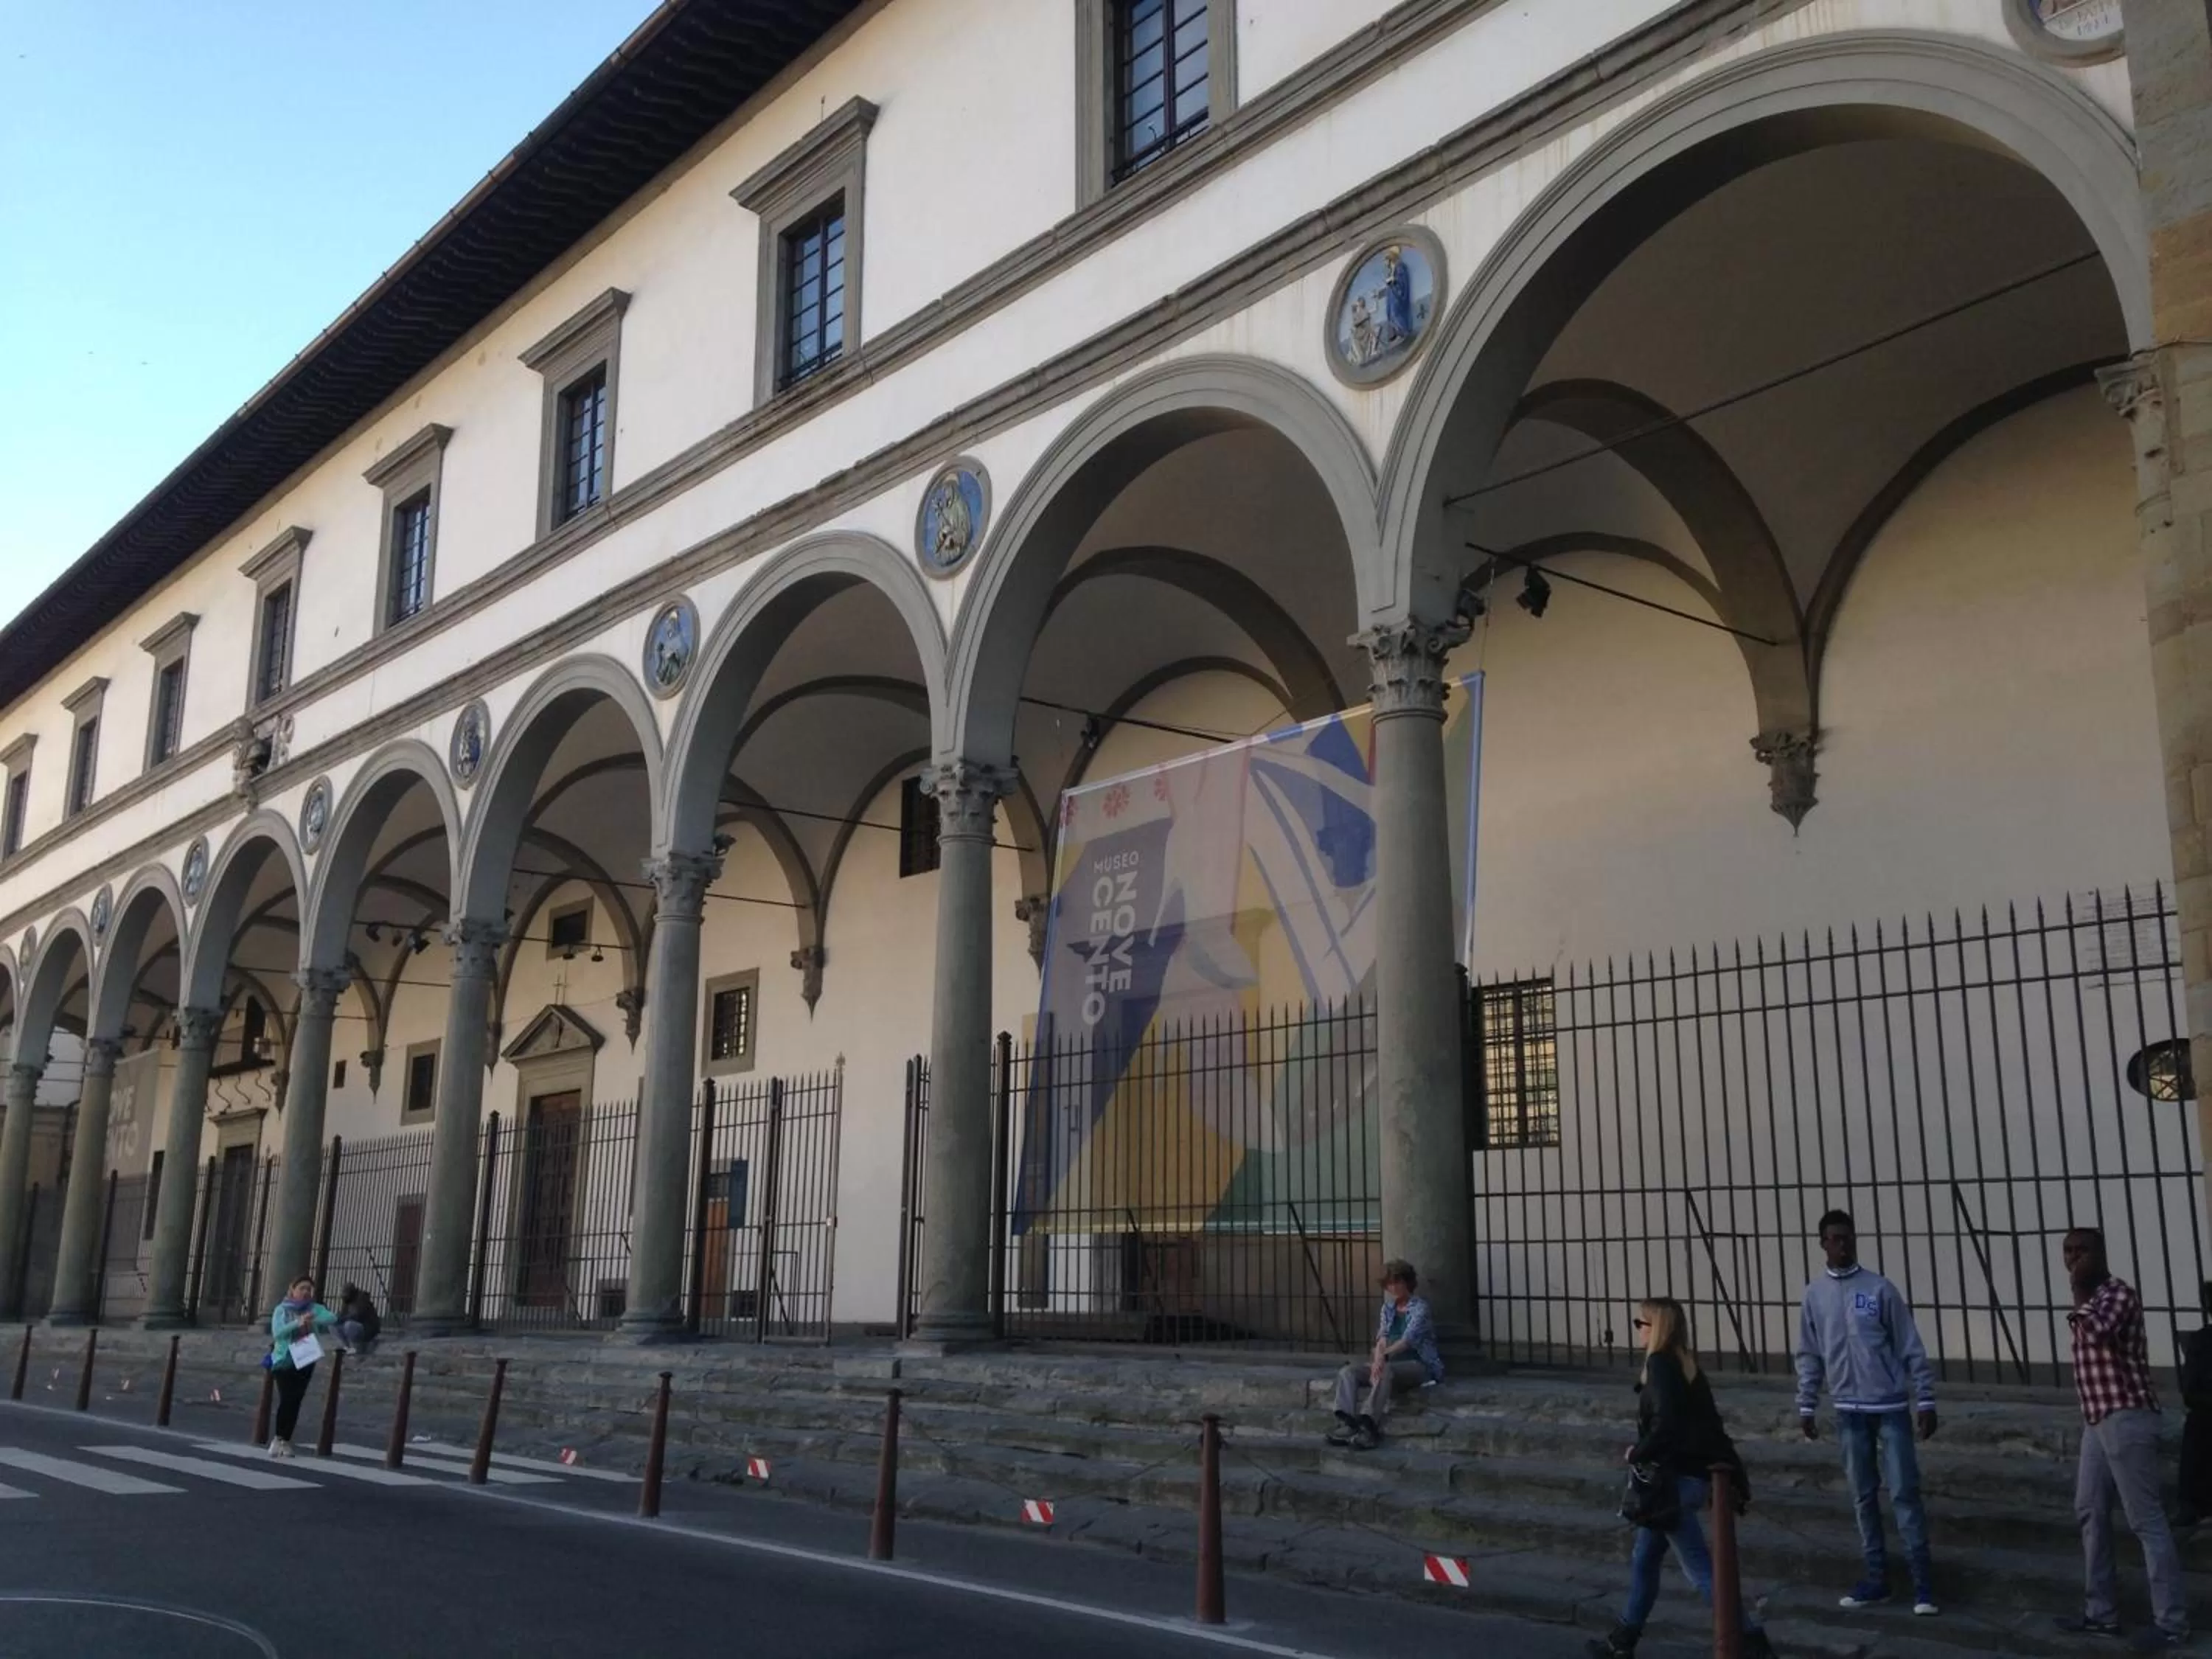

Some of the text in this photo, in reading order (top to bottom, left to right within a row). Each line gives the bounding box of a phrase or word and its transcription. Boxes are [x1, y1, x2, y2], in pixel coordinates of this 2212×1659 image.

[1094, 851, 1140, 874] MUSEO
[1082, 876, 1113, 1025] CENTO
[1109, 871, 1138, 992] NOVE
